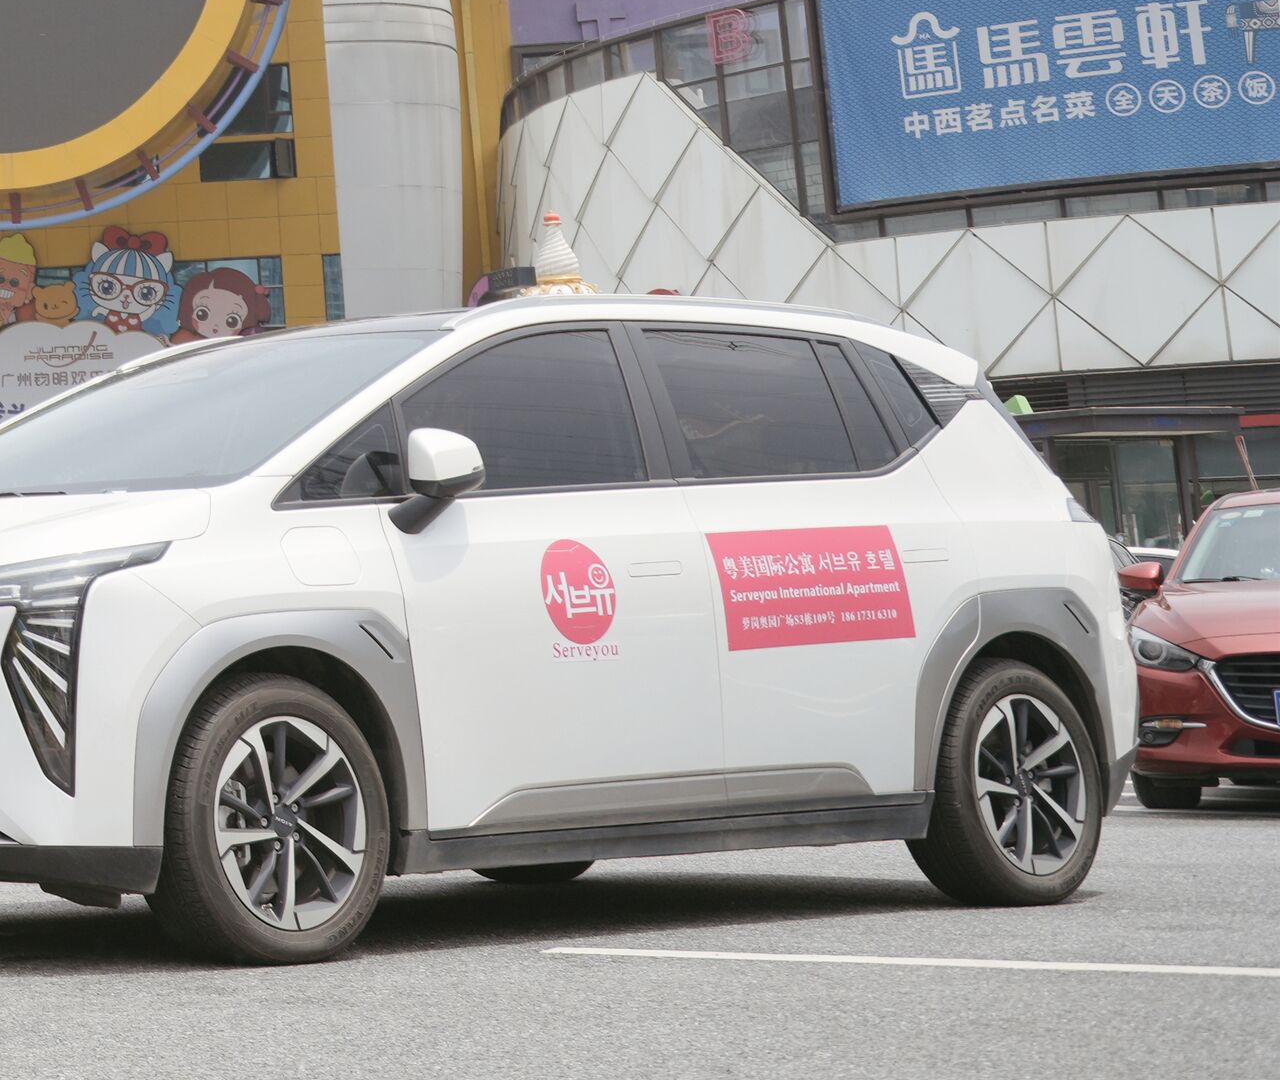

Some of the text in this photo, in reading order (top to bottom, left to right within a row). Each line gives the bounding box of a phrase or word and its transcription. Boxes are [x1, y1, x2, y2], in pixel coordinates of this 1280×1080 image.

[976, 0, 1211, 89] 馬雲軒
[903, 90, 1096, 139] 中西茗点名菜
[1, 370, 111, 388] 广州钧明欢
[722, 548, 896, 580] 粤美国际公寓 서브유 호텔
[544, 563, 615, 619] 서브유
[730, 580, 900, 604] Serveyou International Apartment
[553, 642, 619, 661] Serveyou
